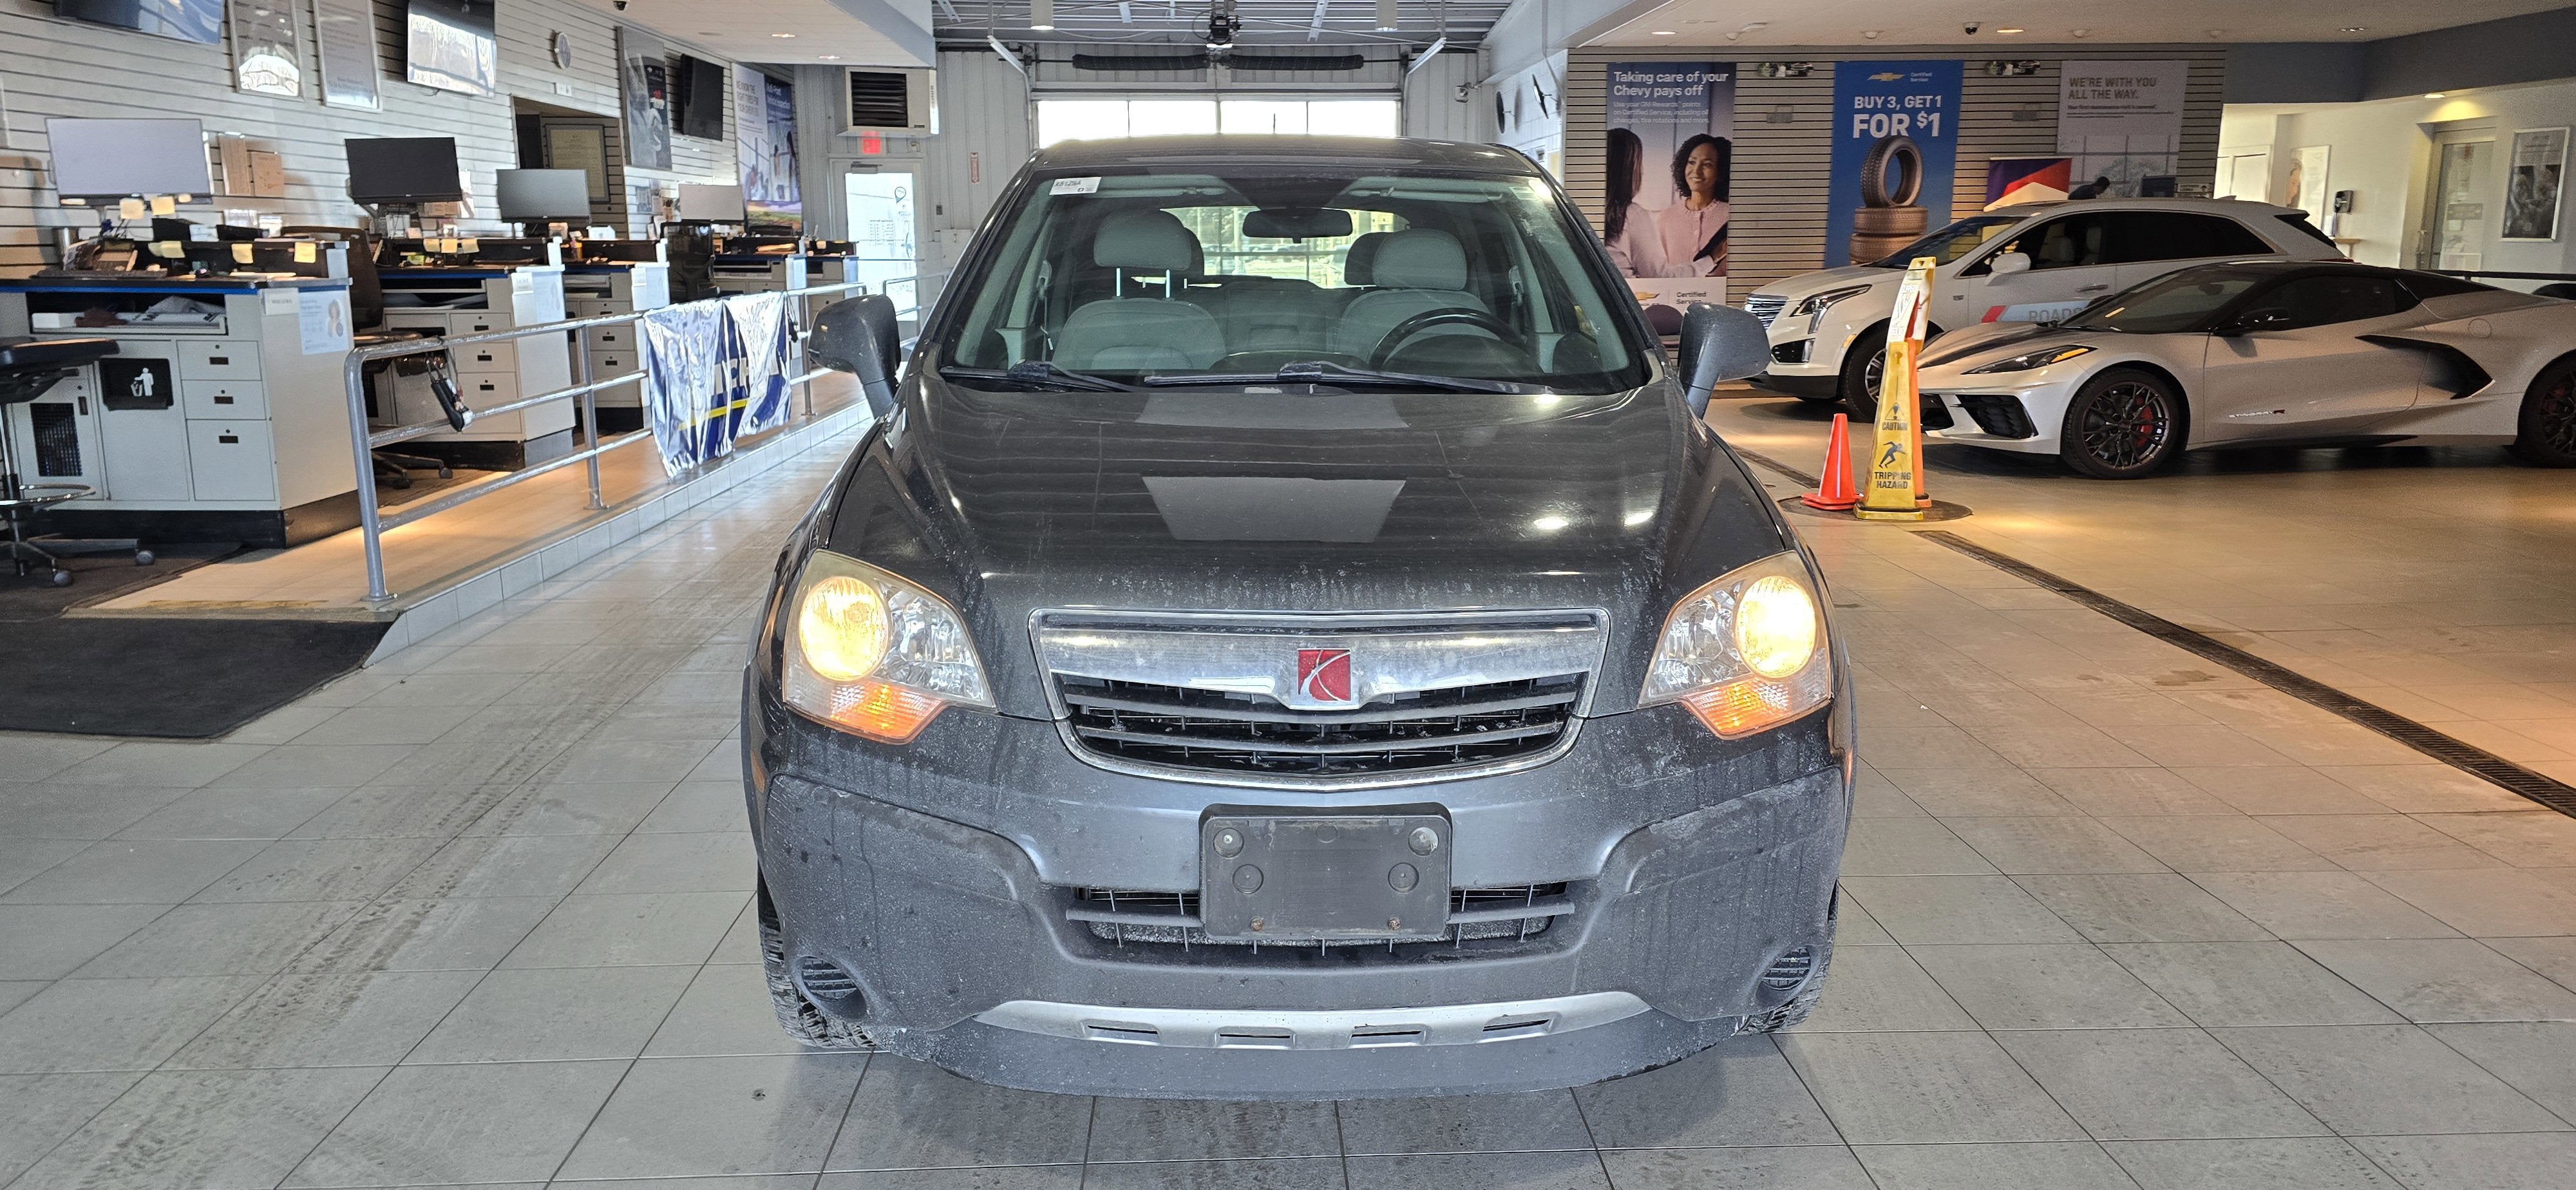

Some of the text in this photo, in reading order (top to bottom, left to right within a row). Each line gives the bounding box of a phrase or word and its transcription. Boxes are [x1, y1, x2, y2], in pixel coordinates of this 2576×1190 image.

[1613, 71, 1729, 84] Taking care of your
[2069, 77, 2157, 87] WE'RE WITH YOU
[1613, 84, 1704, 98] Chevy pays off
[2068, 89, 2140, 99] ALL THE WAY.
[1854, 95, 1942, 111] BUY 3, GET 1
[1853, 110, 1940, 138] FOR $1
[1882, 421, 1908, 431] CAUTION
[1874, 471, 1911, 480] TRIPPNG
[1876, 481, 1908, 489] HAZARD
